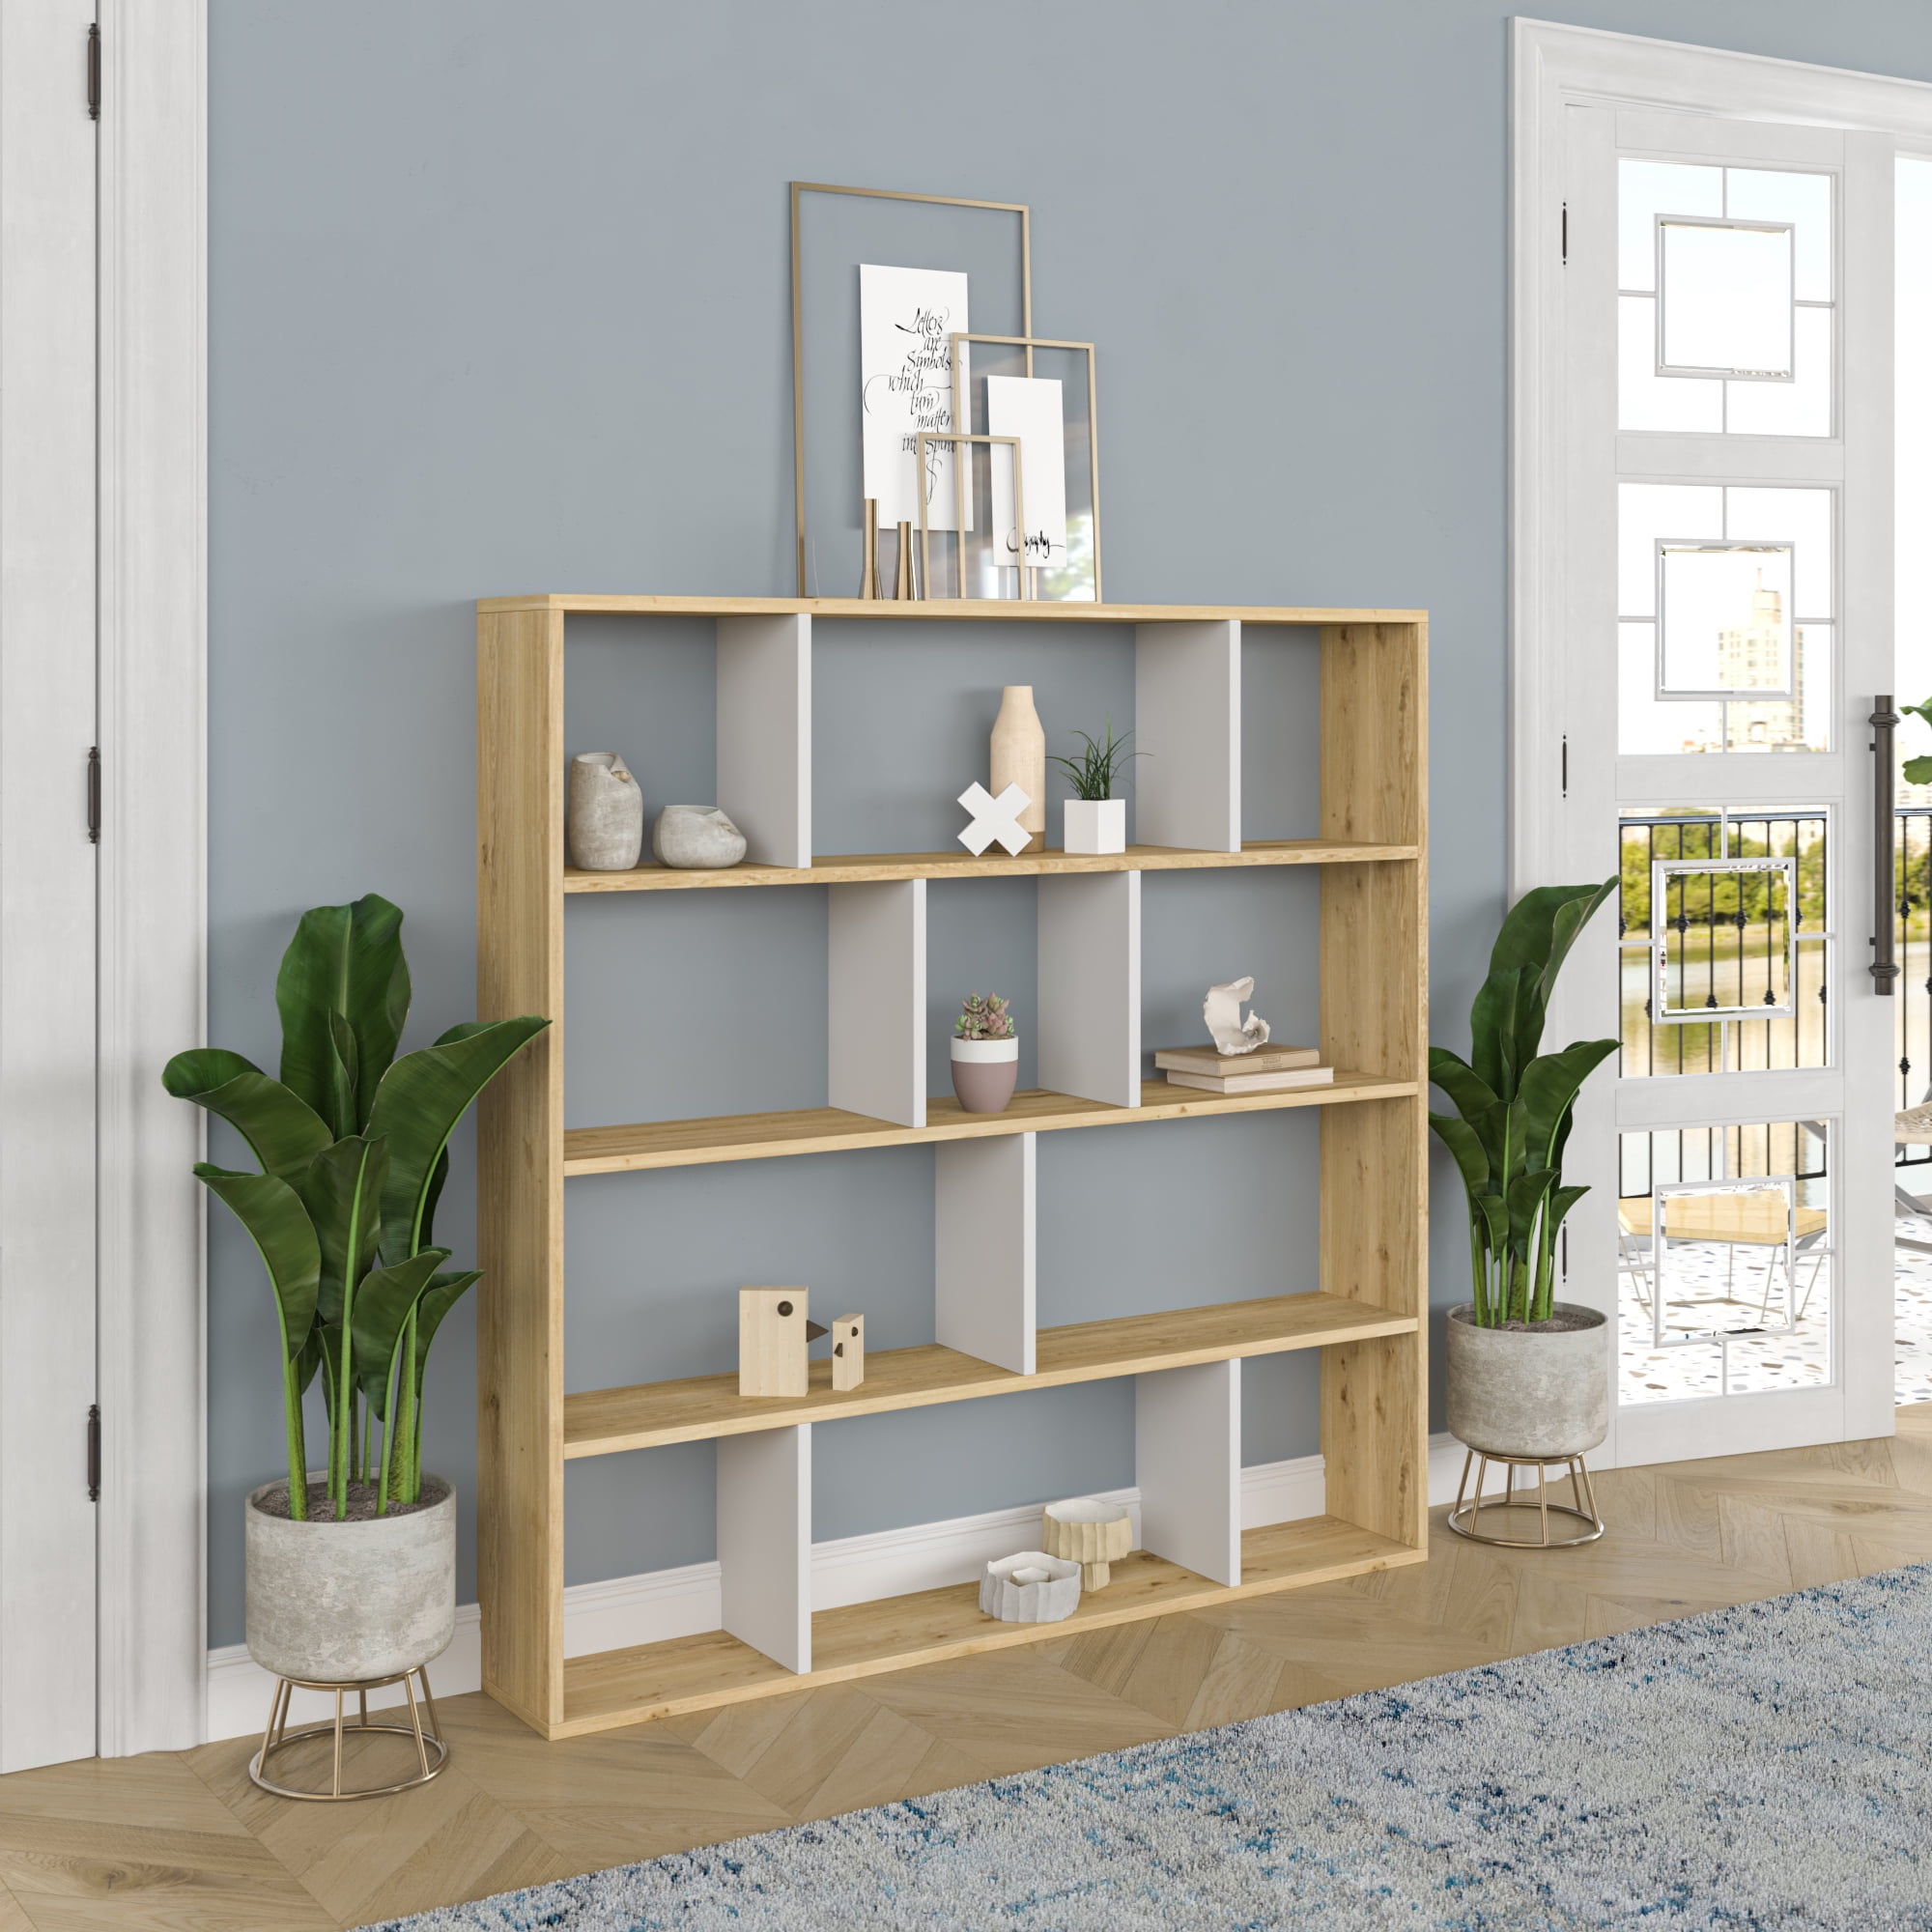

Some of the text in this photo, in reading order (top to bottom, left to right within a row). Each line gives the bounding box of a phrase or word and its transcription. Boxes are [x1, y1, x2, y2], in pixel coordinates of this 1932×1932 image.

[895, 306, 950, 338] Letters
[923, 336, 949, 352] are
[914, 408, 952, 434] matter
[902, 433, 919, 455] int
